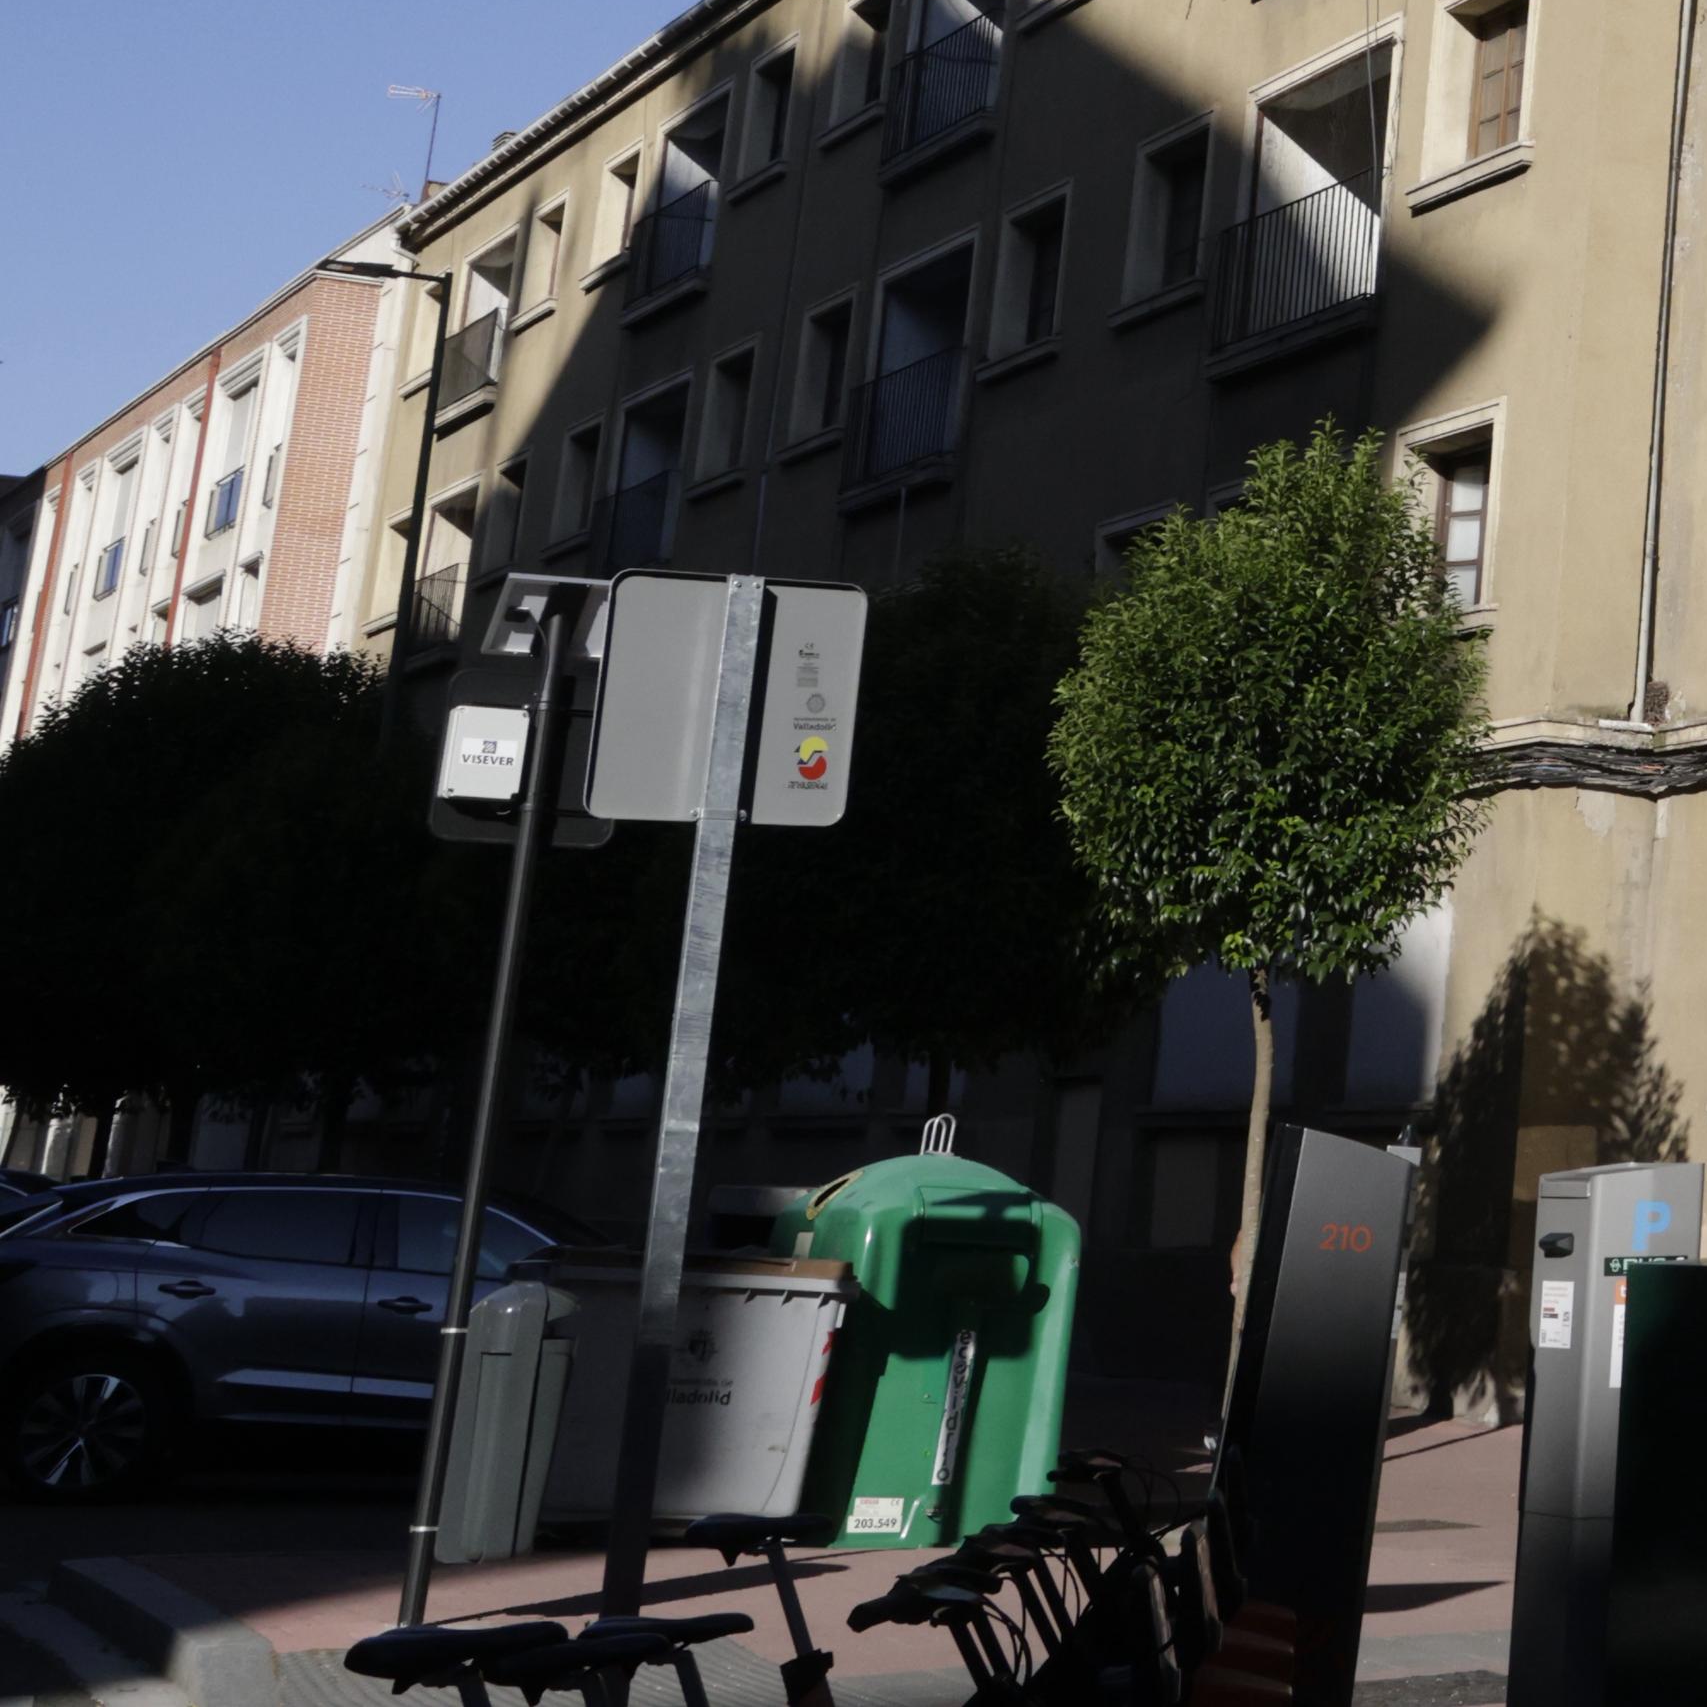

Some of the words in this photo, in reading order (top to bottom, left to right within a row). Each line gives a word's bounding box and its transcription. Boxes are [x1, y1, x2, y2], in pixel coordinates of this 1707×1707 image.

[461, 753, 514, 766] VISEVER
[1631, 1199, 1672, 1252] P
[1317, 1222, 1374, 1254] 210
[666, 1389, 732, 1406] lladolid
[854, 1518, 898, 1529] 203.549
